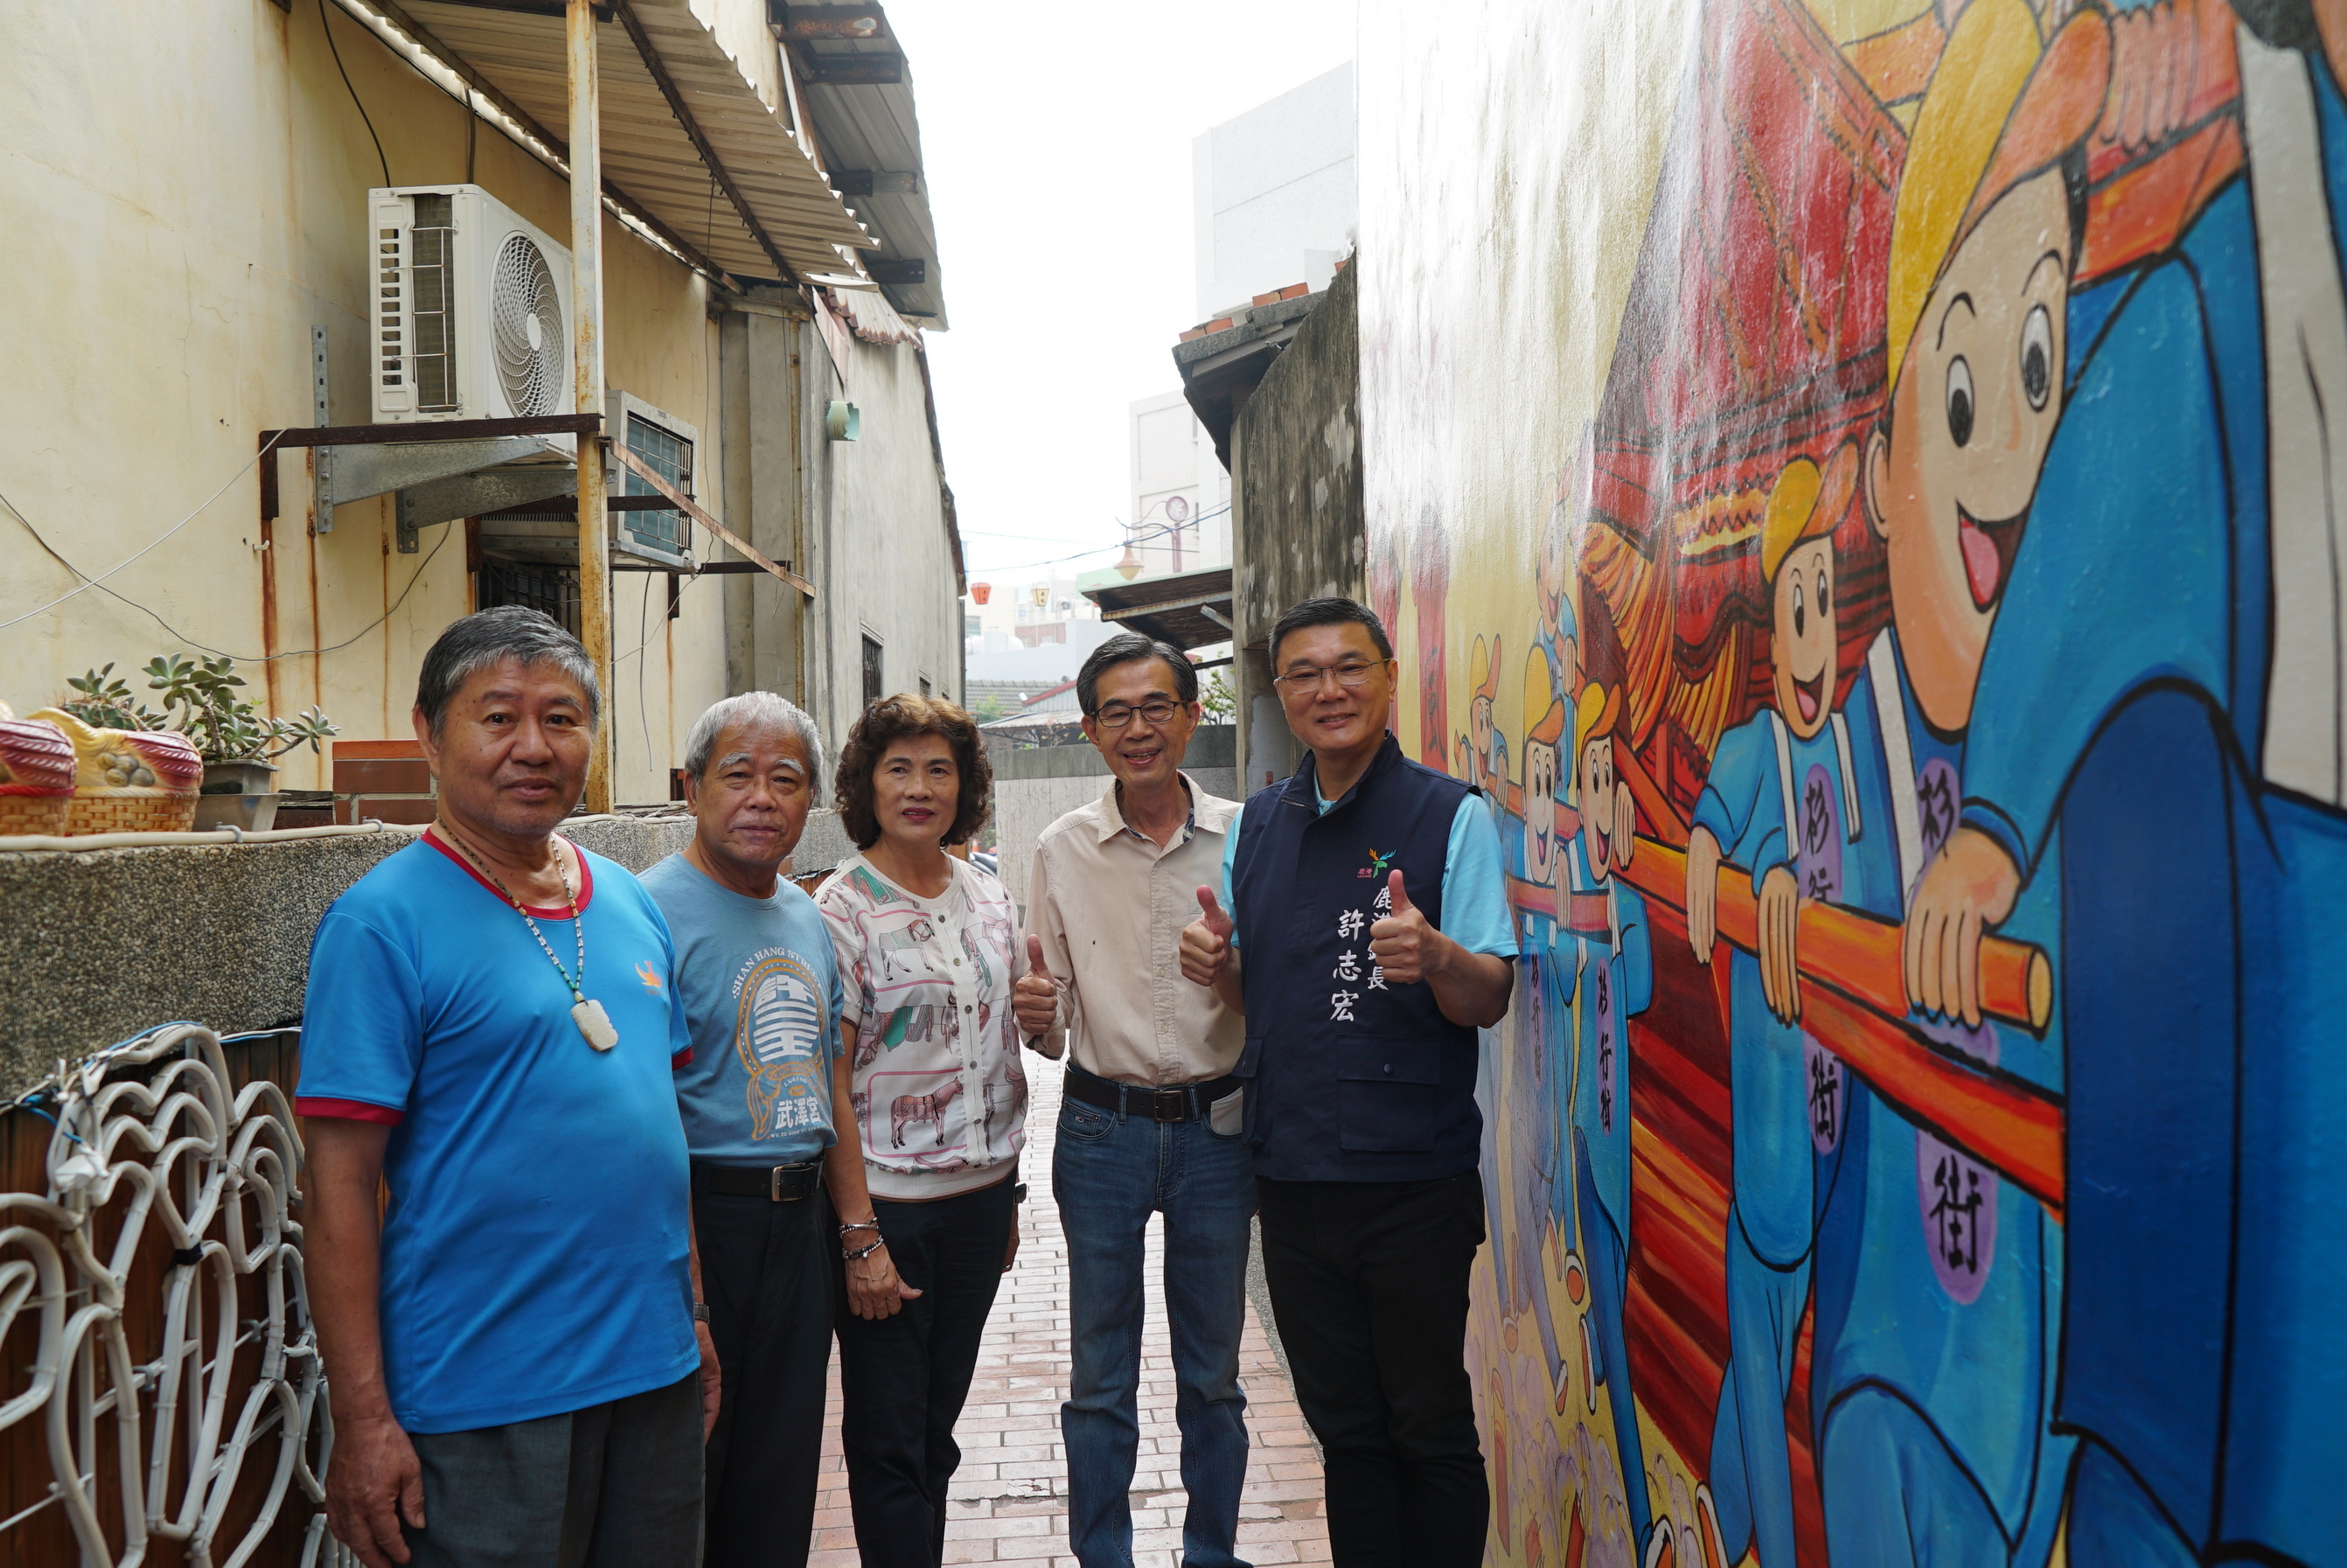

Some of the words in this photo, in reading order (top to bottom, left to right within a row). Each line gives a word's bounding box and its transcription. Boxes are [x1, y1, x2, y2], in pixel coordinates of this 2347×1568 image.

[732, 957, 756, 996] SHAN
[754, 946, 785, 961] HANG
[1330, 909, 1365, 1021] 許志宏
[776, 1096, 820, 1130] 武澤宮
